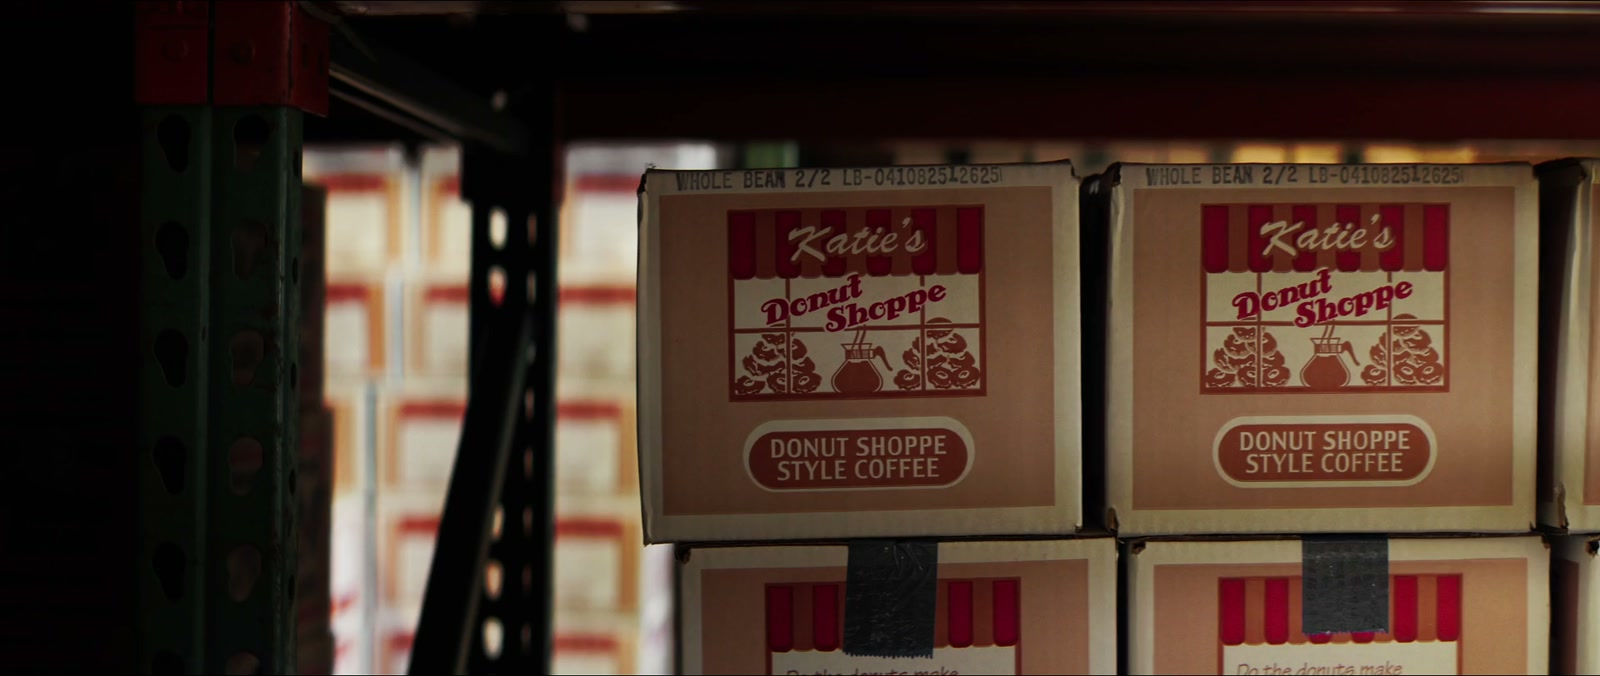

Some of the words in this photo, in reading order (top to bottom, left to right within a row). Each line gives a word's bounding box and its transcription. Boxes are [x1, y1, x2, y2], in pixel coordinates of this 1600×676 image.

[676, 171, 733, 191] WHOLE
[743, 170, 786, 189] BEAN
[795, 168, 831, 188] 2/2
[843, 166, 1003, 186] LB-041082512625
[1146, 167, 1202, 186] WHOLE
[1212, 166, 1253, 185] BEAN
[1263, 165, 1298, 185] 2/2
[1309, 165, 1464, 184] LB-041082512625
[788, 216, 926, 263] Katie's
[1258, 213, 1395, 257] Katie's
[761, 273, 863, 326] Donut
[825, 283, 946, 333] Shoppe
[1231, 268, 1333, 320] Donut
[1294, 280, 1413, 328] Shoppe
[770, 437, 849, 459] DONUT
[856, 435, 947, 457] SHOPPE
[1239, 431, 1317, 451] DONUT
[1322, 430, 1411, 450] SHOPPE
[777, 459, 847, 481] STYLE
[854, 457, 940, 480] COFFEE
[1245, 453, 1314, 473] STYLE
[1321, 452, 1404, 473] COFFEE
